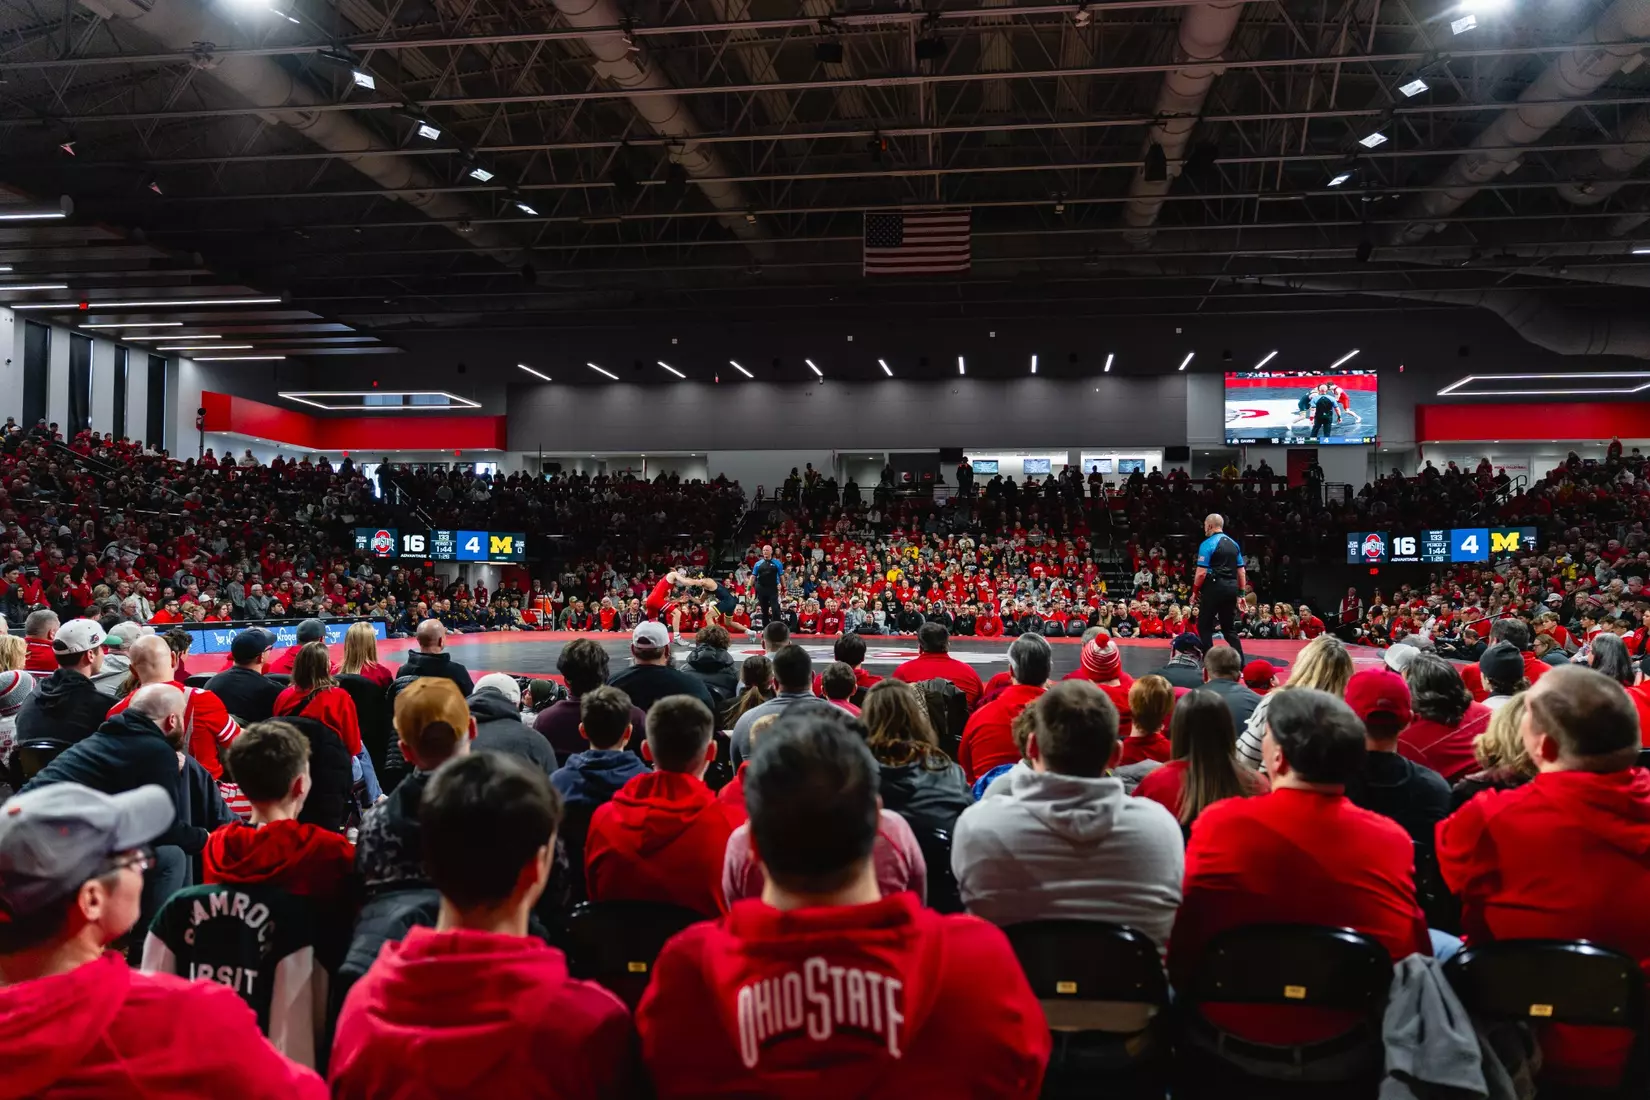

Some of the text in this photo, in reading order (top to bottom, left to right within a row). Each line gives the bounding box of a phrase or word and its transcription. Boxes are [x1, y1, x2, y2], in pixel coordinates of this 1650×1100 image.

[403, 535, 424, 552] 16
[465, 537, 480, 553] 4
[490, 536, 513, 553] M
[1393, 537, 1416, 555] 16
[1461, 535, 1479, 553] 4
[1491, 532, 1519, 552] M
[738, 957, 904, 1068] OHIO STATE
